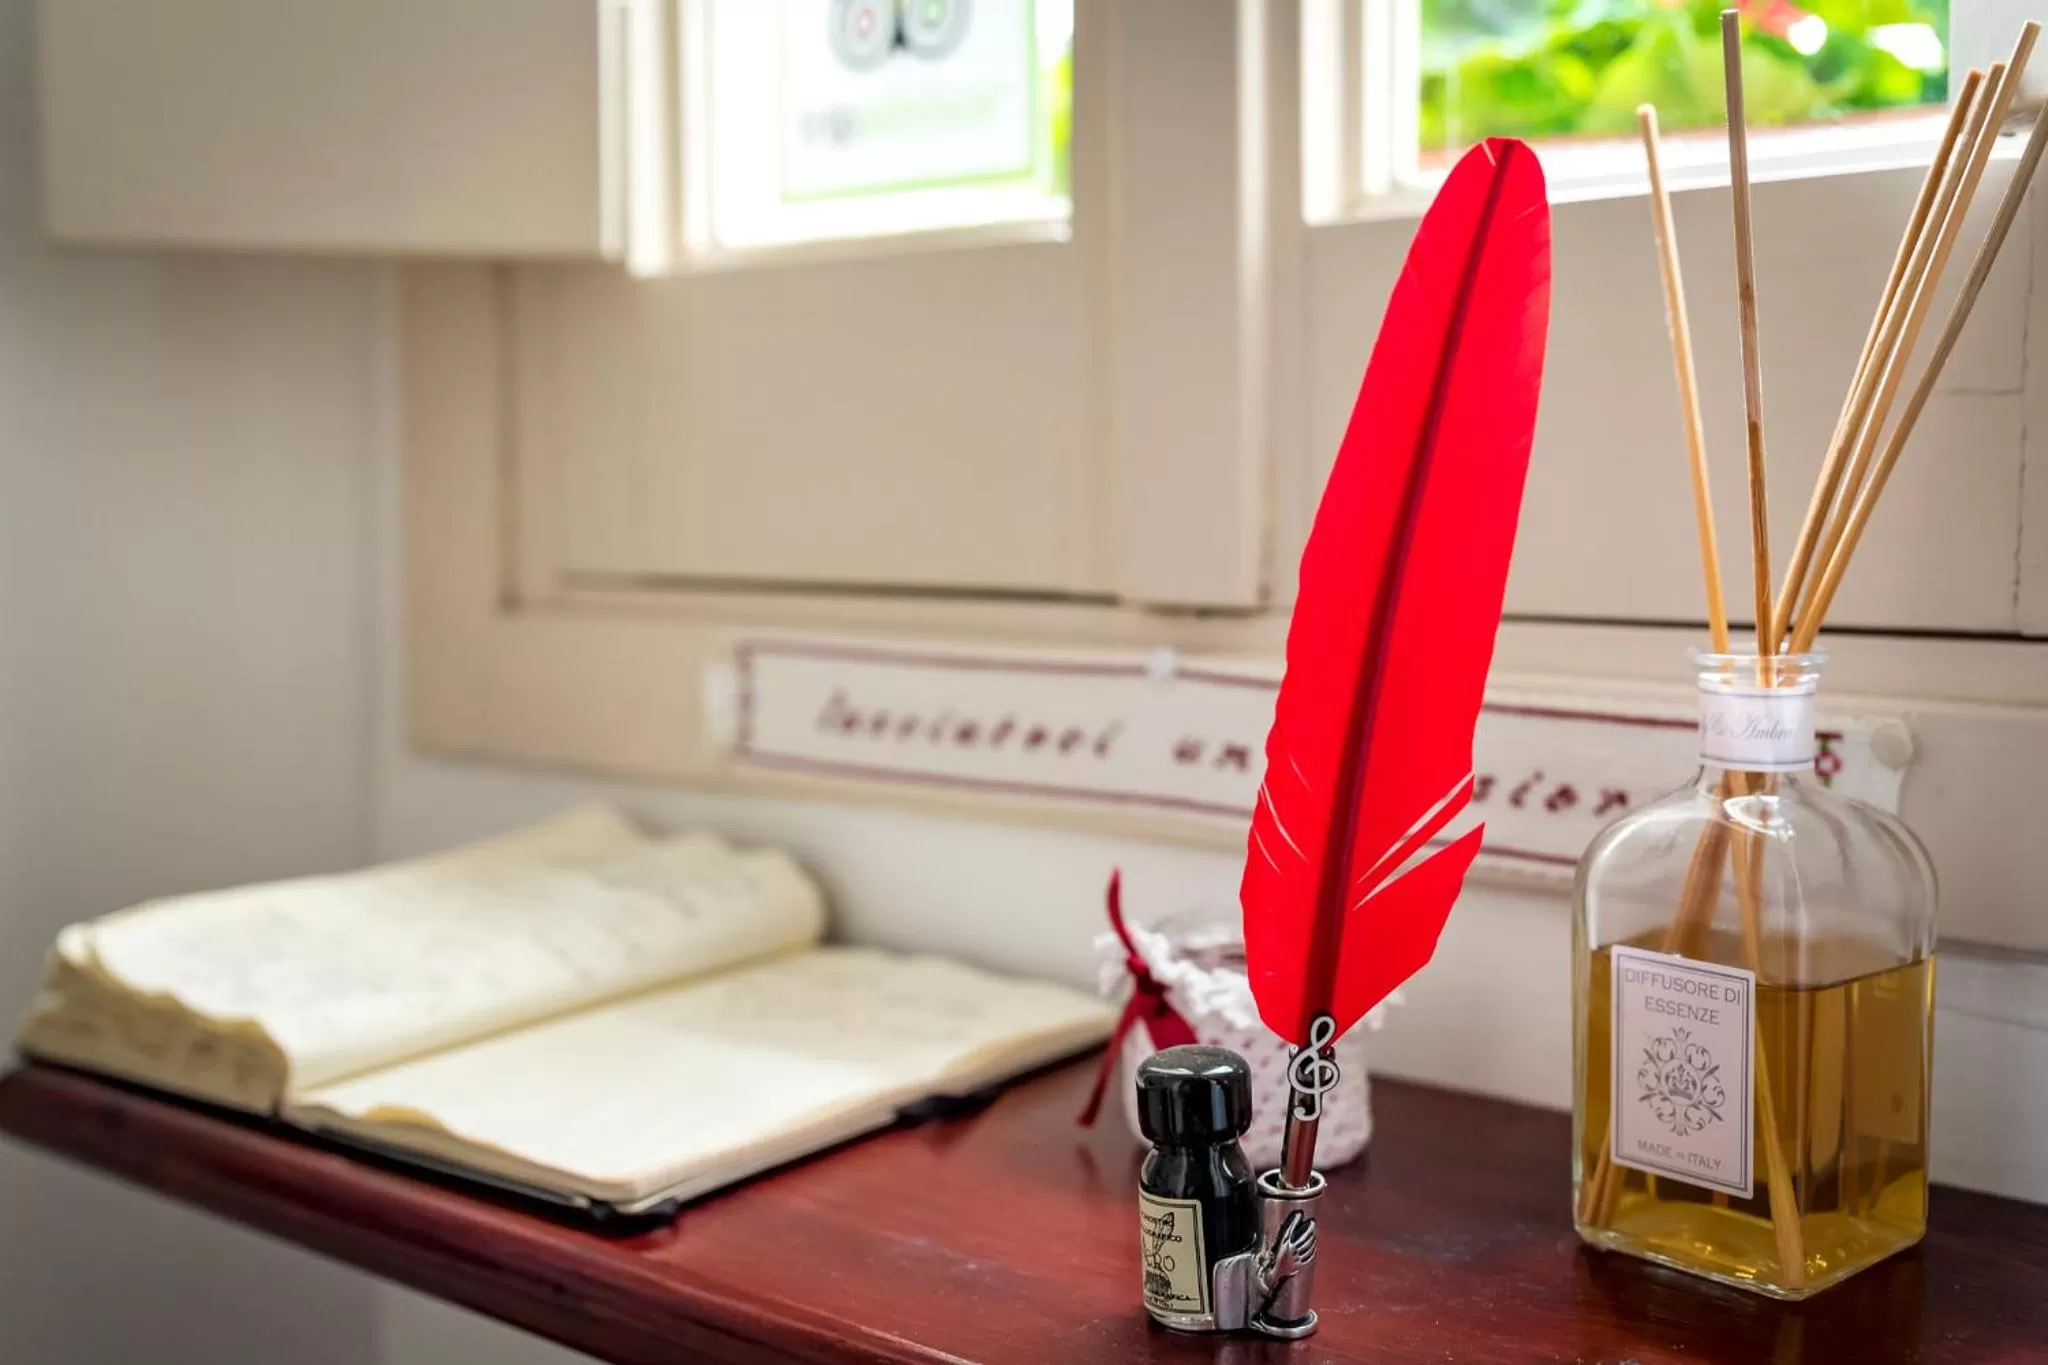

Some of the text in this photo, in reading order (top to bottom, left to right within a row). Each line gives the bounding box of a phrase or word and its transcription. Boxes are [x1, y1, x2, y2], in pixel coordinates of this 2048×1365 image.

[1626, 968, 1740, 1005] DIFFUSORE DI
[1645, 996, 1720, 1025] ESSENZE
[1638, 1139, 1672, 1158] MADE
[1687, 1151, 1721, 1172] ITALY
